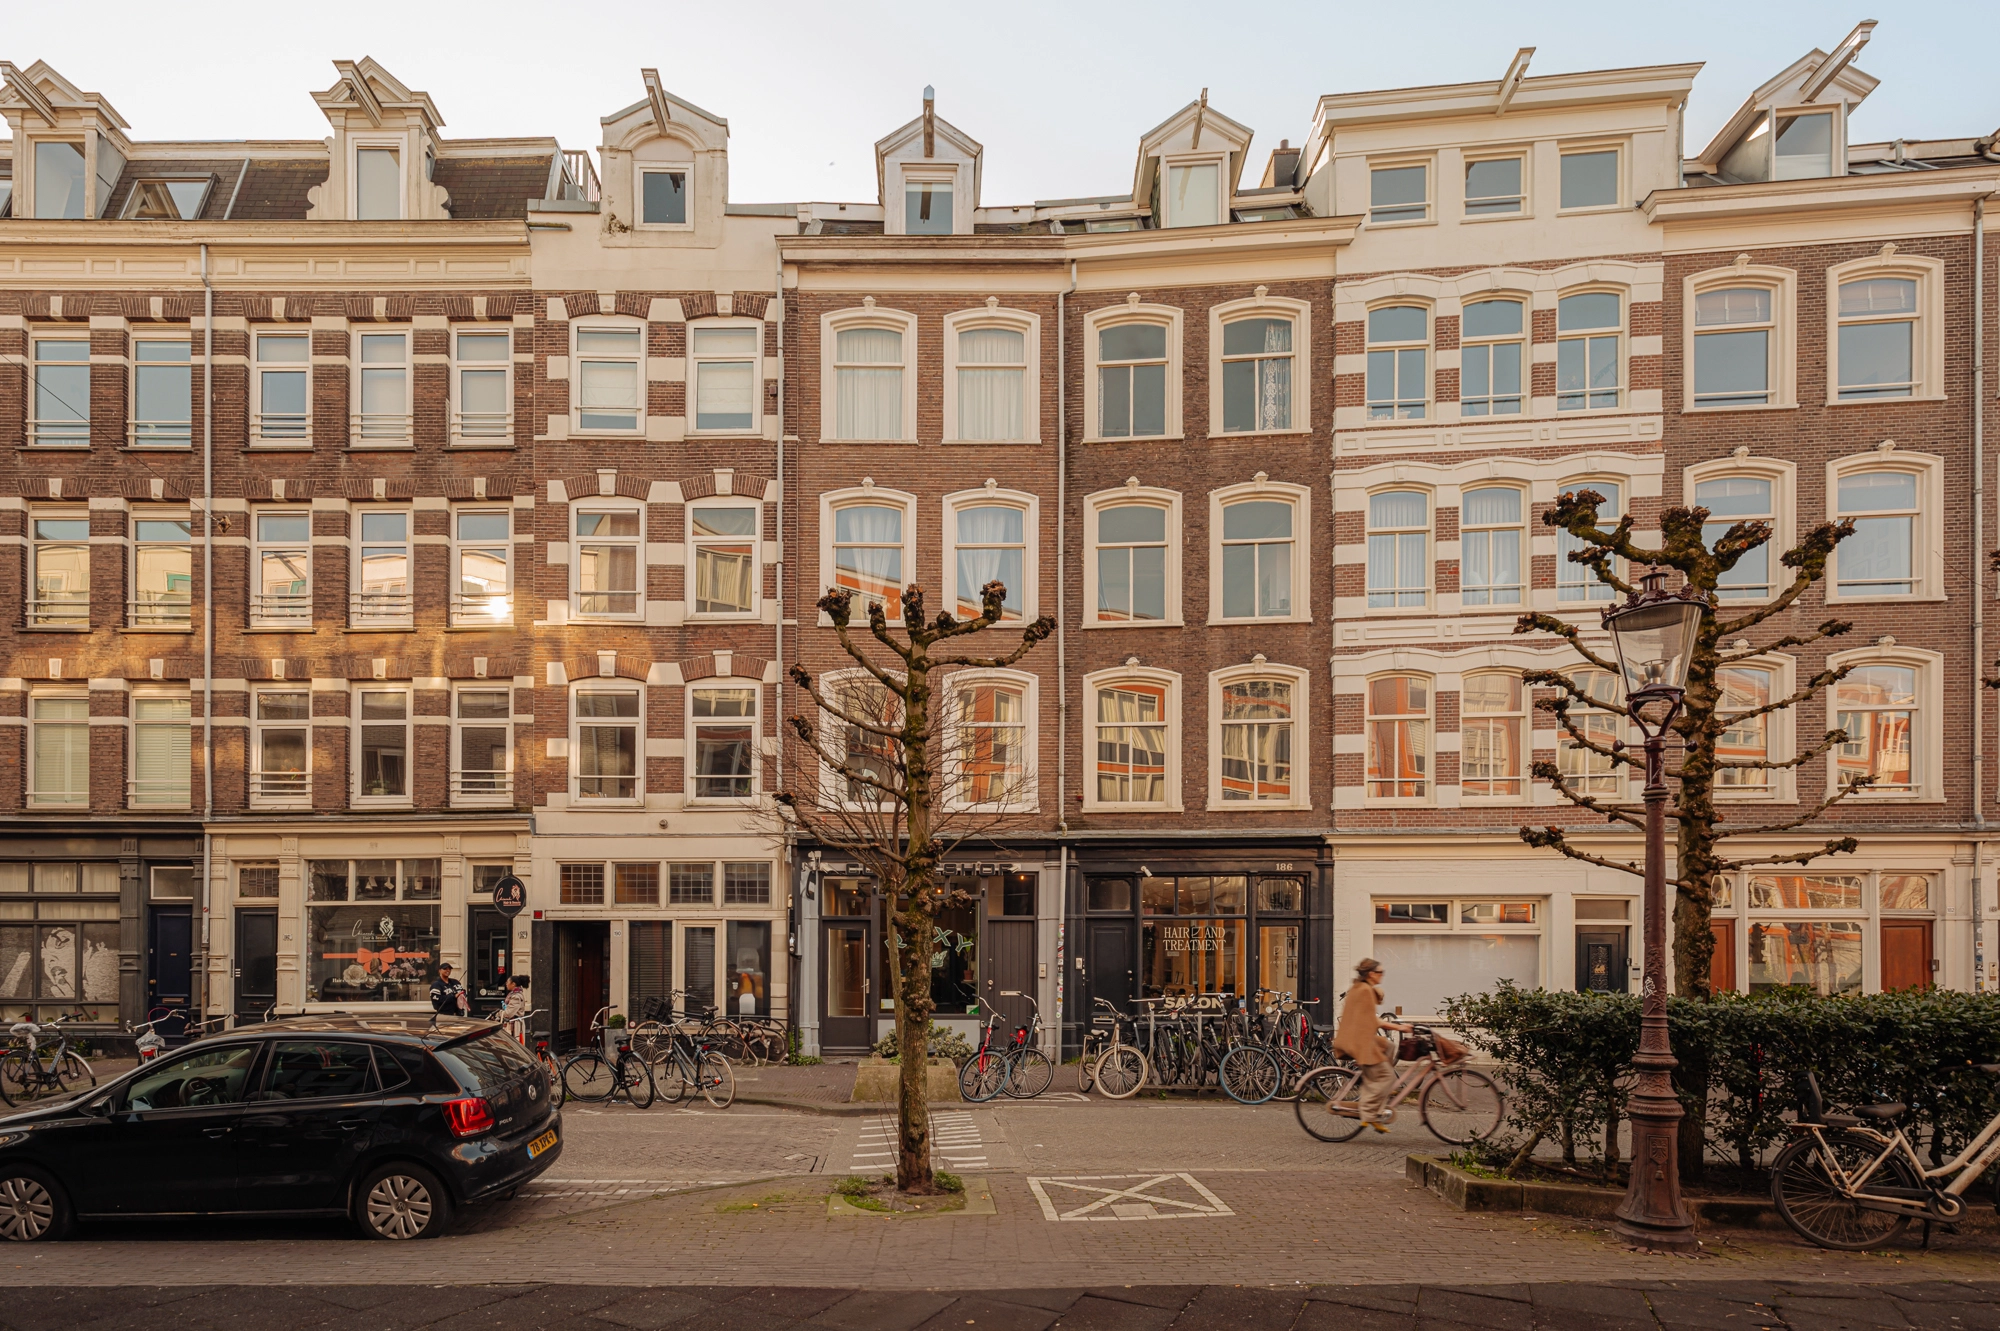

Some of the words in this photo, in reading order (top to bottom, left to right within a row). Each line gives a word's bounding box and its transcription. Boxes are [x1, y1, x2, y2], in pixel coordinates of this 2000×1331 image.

[1276, 863, 1293, 871] 186
[1164, 927, 1190, 938] HAIR
[1205, 927, 1226, 938] AND
[884, 926, 974, 952] RXY
[1163, 940, 1226, 951] TREATMENT
[499, 1117, 512, 1125] POLO
